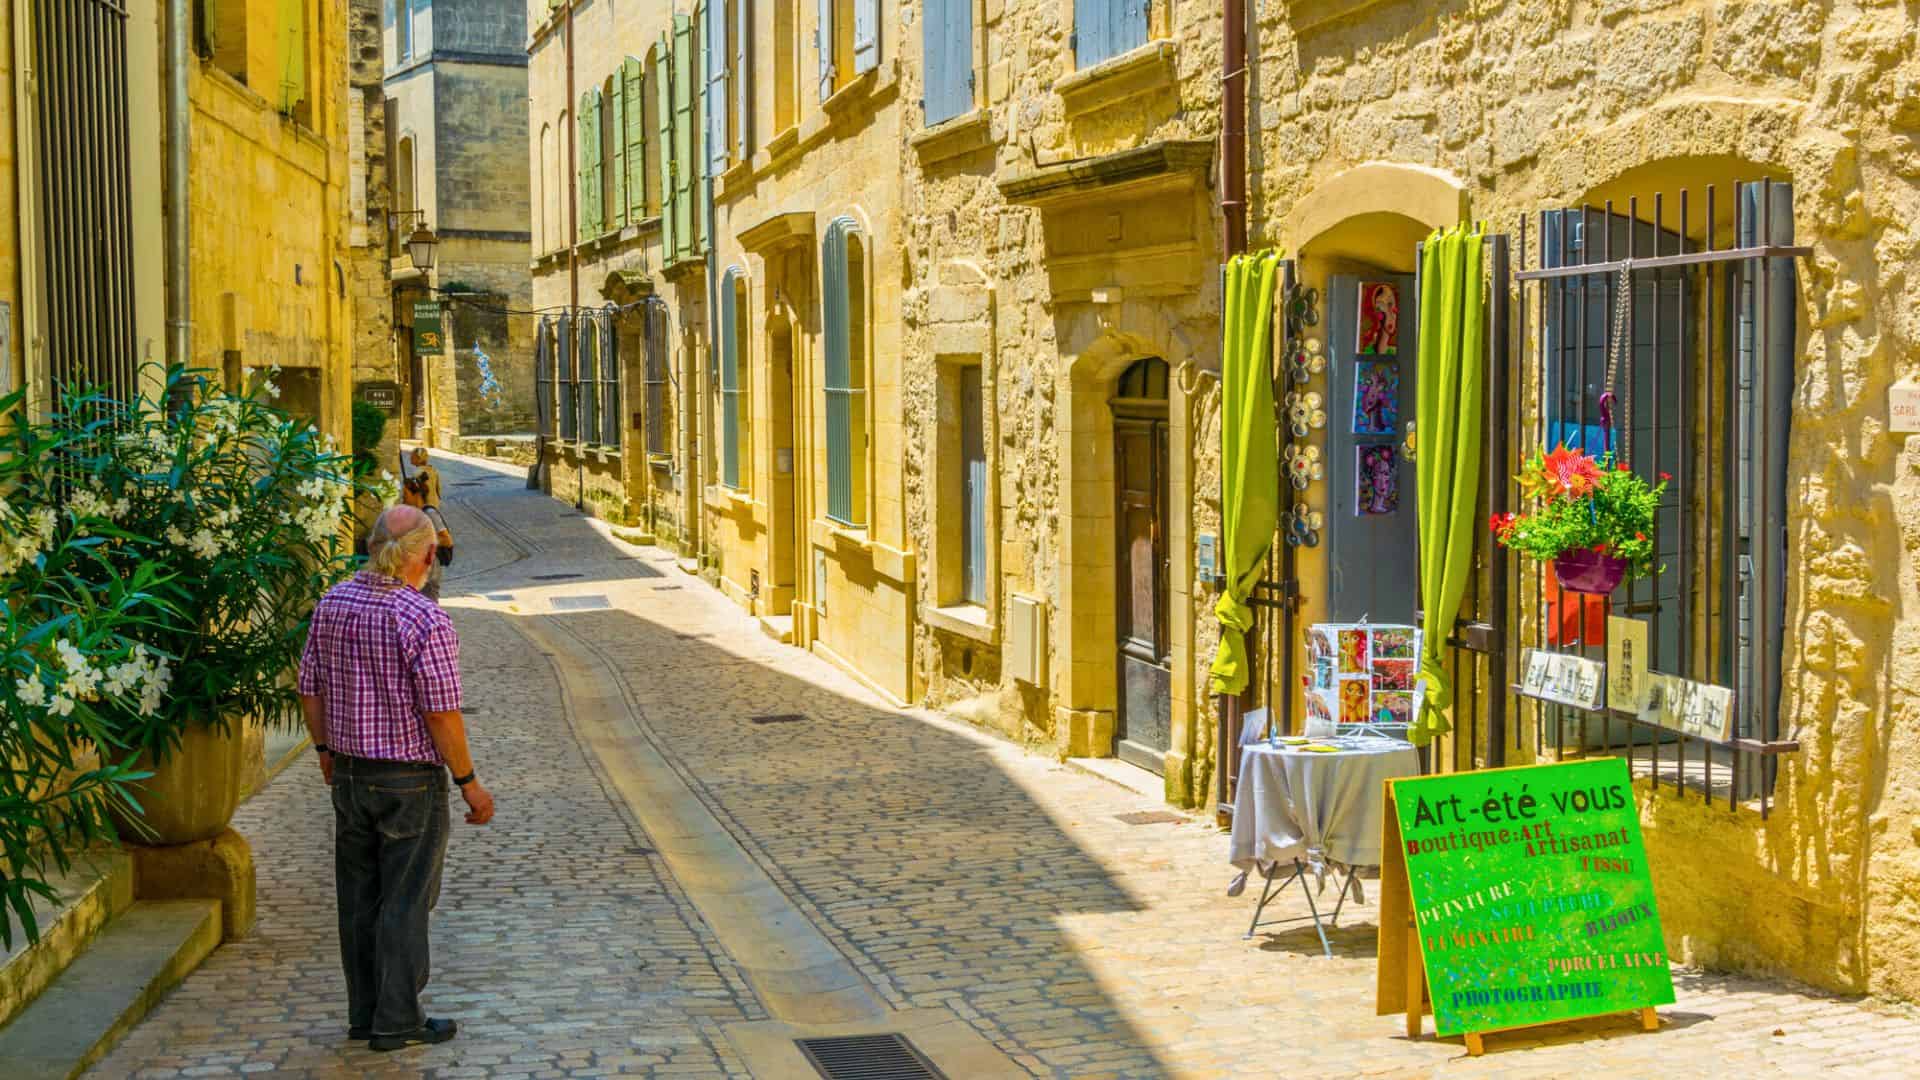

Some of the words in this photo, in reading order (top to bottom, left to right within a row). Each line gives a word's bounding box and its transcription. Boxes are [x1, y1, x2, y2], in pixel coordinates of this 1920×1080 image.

[1414, 783, 1537, 828] Art-été
[1551, 785, 1626, 816] vous
[1524, 826, 1631, 858] Artisanat
[1579, 854, 1634, 875] TISSU
[1419, 879, 1516, 926] PEINTURE
[1427, 924, 1537, 952] LUMINAIRE
[1548, 951, 1665, 973] PORCELAINE
[1451, 980, 1605, 1010] PHOTOGRAPHIE
